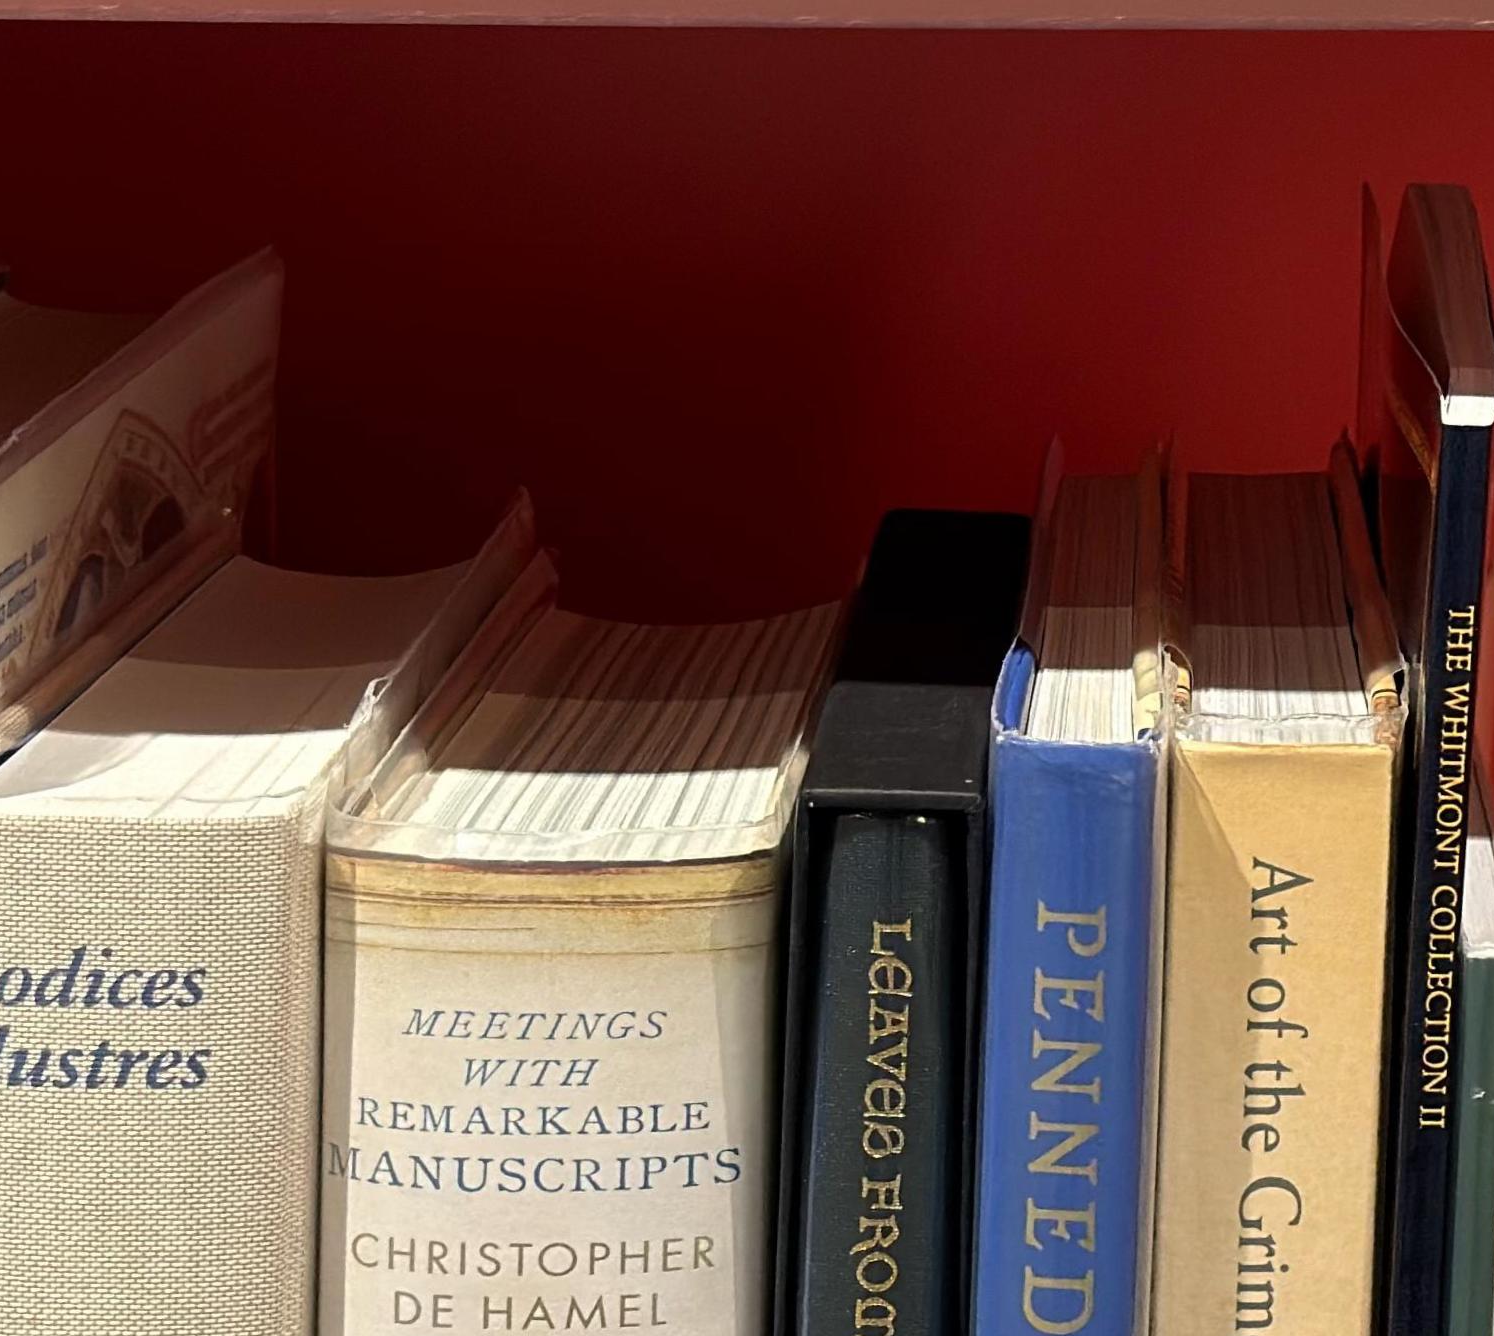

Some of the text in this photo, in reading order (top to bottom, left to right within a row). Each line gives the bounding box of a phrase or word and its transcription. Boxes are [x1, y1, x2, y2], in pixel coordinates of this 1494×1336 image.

[1419, 606, 1475, 1128] THE WHITMONT COLLECTION II
[1249, 857, 1314, 954] Art
[402, 1009, 667, 1040] MEETINGS
[1247, 979, 1308, 1038] of
[465, 1059, 599, 1086] WITH
[359, 1098, 709, 1135] REMARKABLE
[1023, 899, 1106, 1334] PENNED
[1242, 1060, 1305, 1152] the
[329, 1143, 740, 1192] MANUSCRIPTS
[352, 1233, 714, 1276] CHRISTOPHER
[394, 1291, 666, 1330] DE HAMEL
